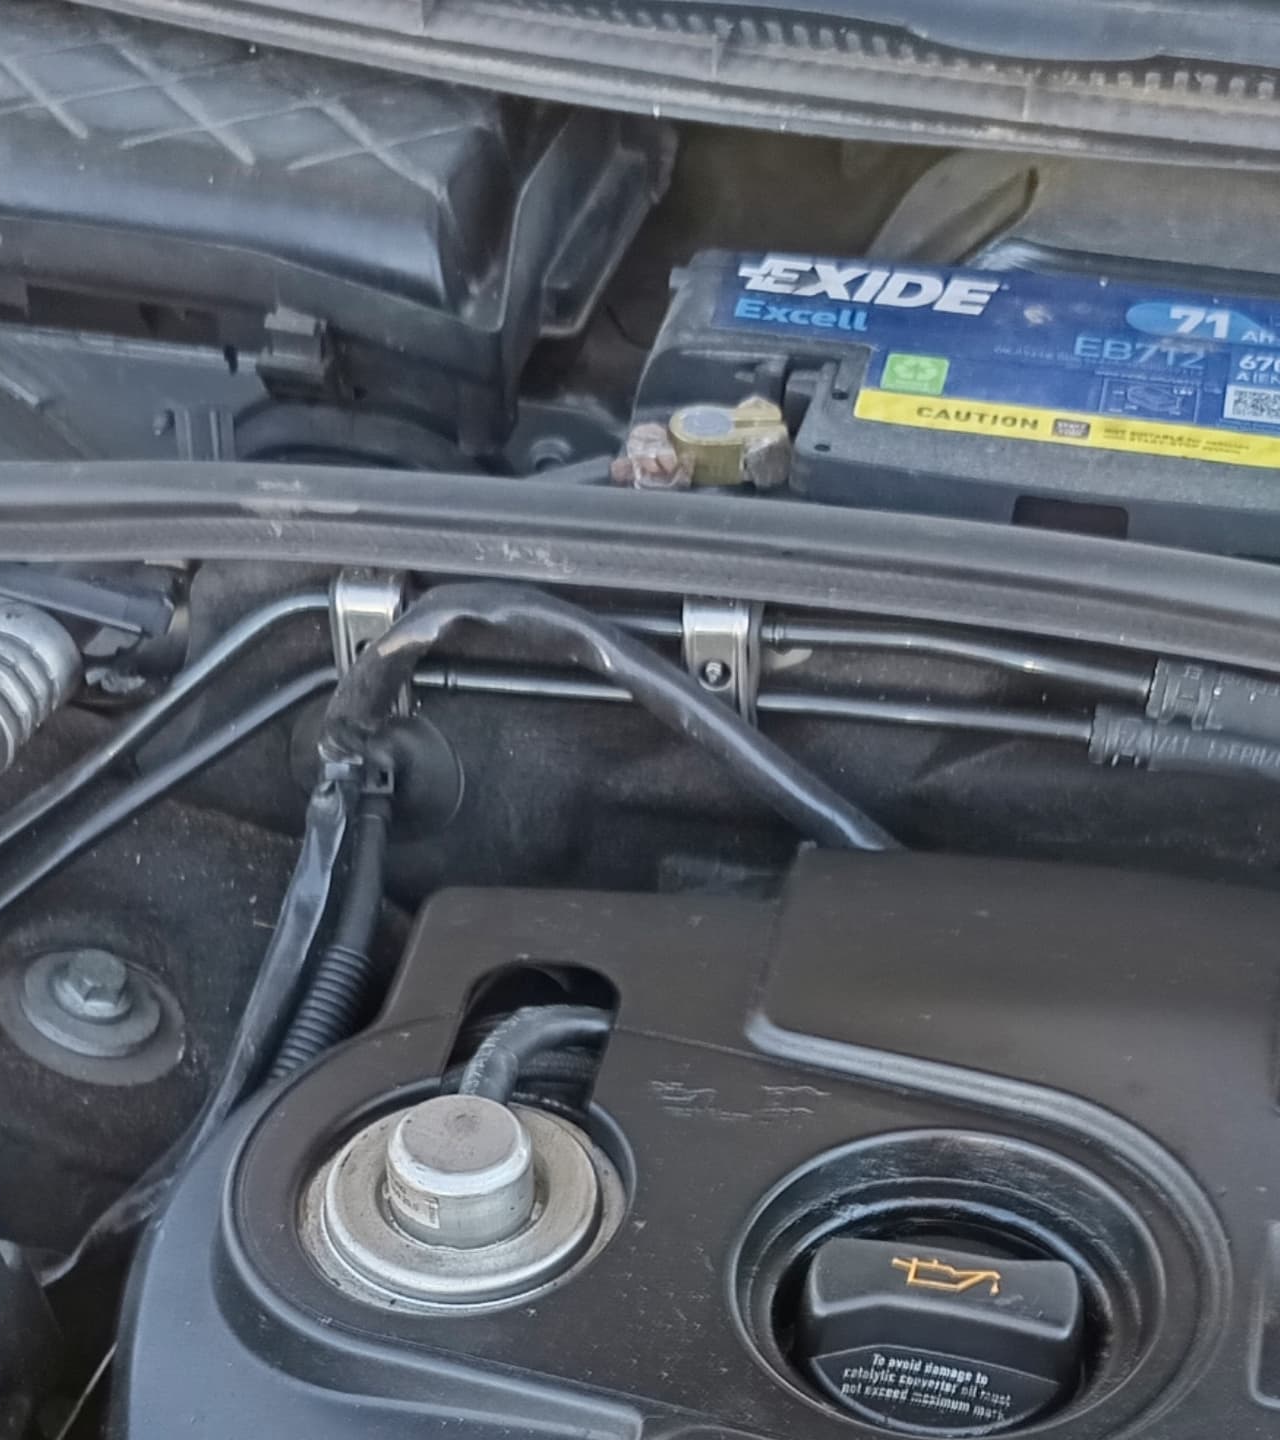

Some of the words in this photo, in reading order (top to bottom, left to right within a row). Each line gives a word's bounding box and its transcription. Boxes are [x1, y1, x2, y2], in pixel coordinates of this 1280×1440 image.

[738, 255, 1001, 316] EXIDE
[734, 298, 869, 332] Excell
[1170, 306, 1232, 339] 71
[1074, 335, 1205, 371] EB712
[916, 405, 1040, 432] CAUTION
[842, 1366, 897, 1385] catalytic
[898, 1373, 958, 1395] converter
[872, 1353, 886, 1367] To
[888, 1358, 922, 1372] avoid
[924, 1361, 973, 1383] damage
[975, 1371, 989, 1386] to
[841, 1382, 862, 1396] not
[863, 1385, 910, 1401] exceed
